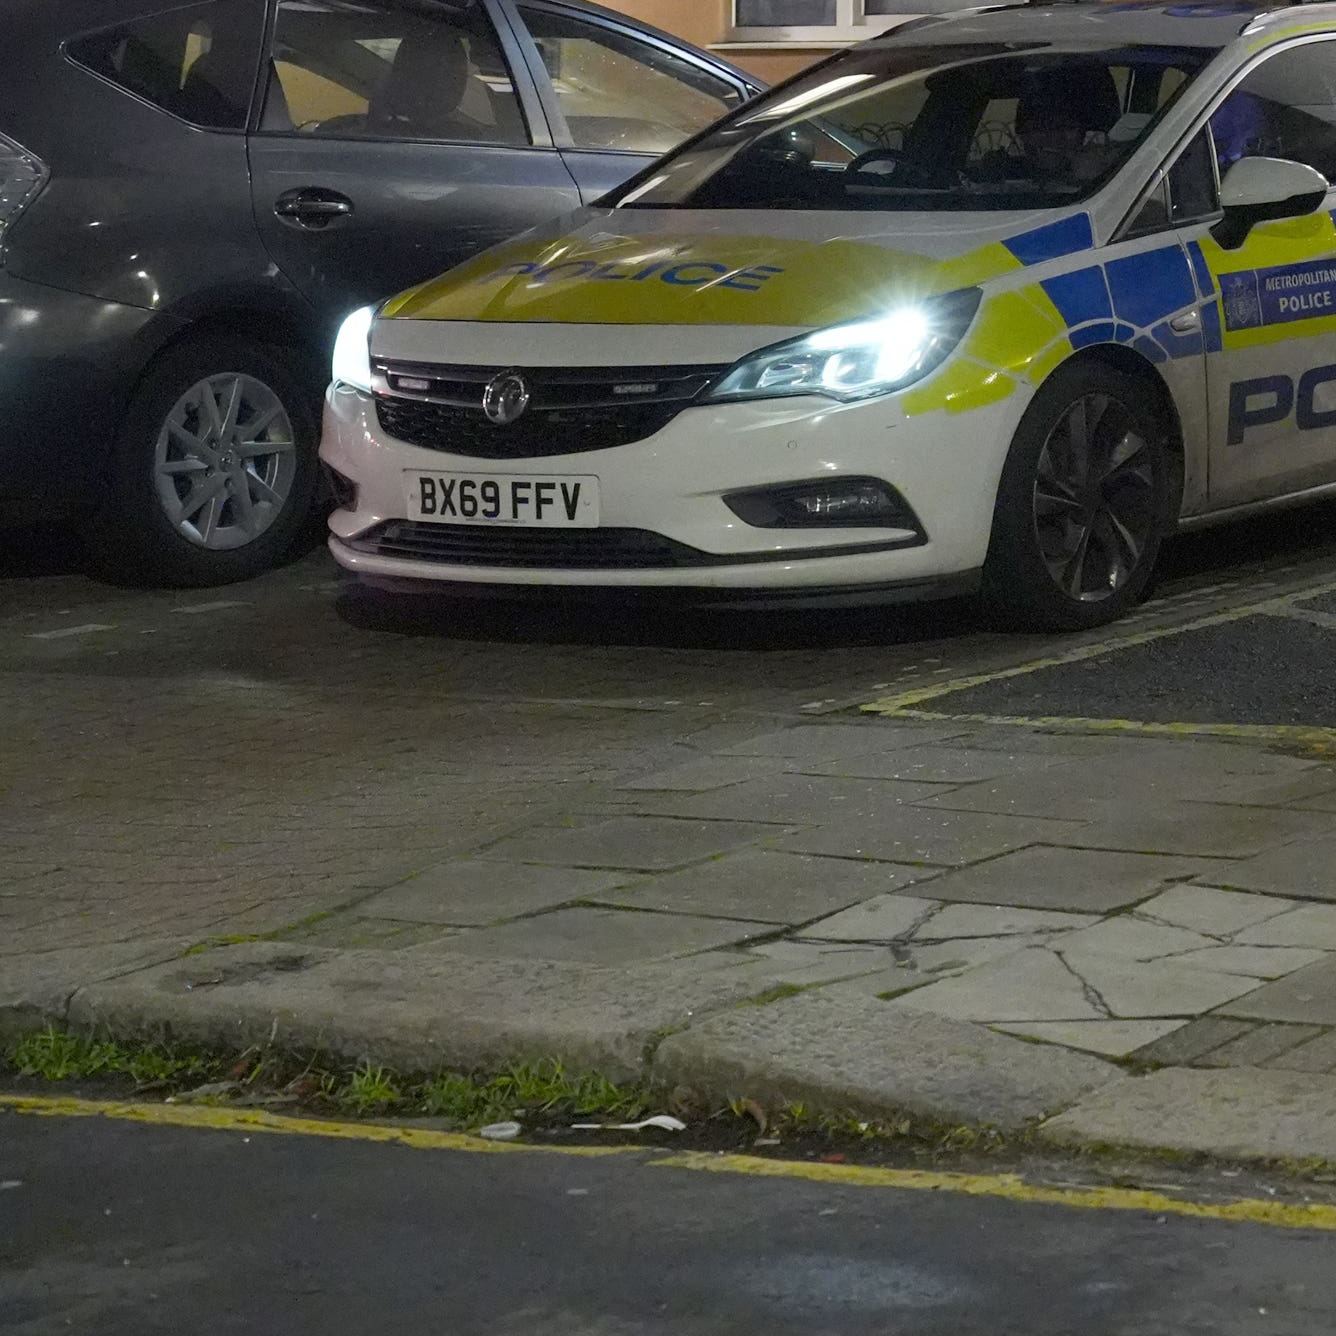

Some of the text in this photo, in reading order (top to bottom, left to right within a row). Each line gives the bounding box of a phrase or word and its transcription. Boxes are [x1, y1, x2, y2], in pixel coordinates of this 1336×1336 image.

[478, 259, 786, 292] POLICE
[1278, 291, 1332, 313] POLICE
[419, 476, 581, 521] BX69 FFV
